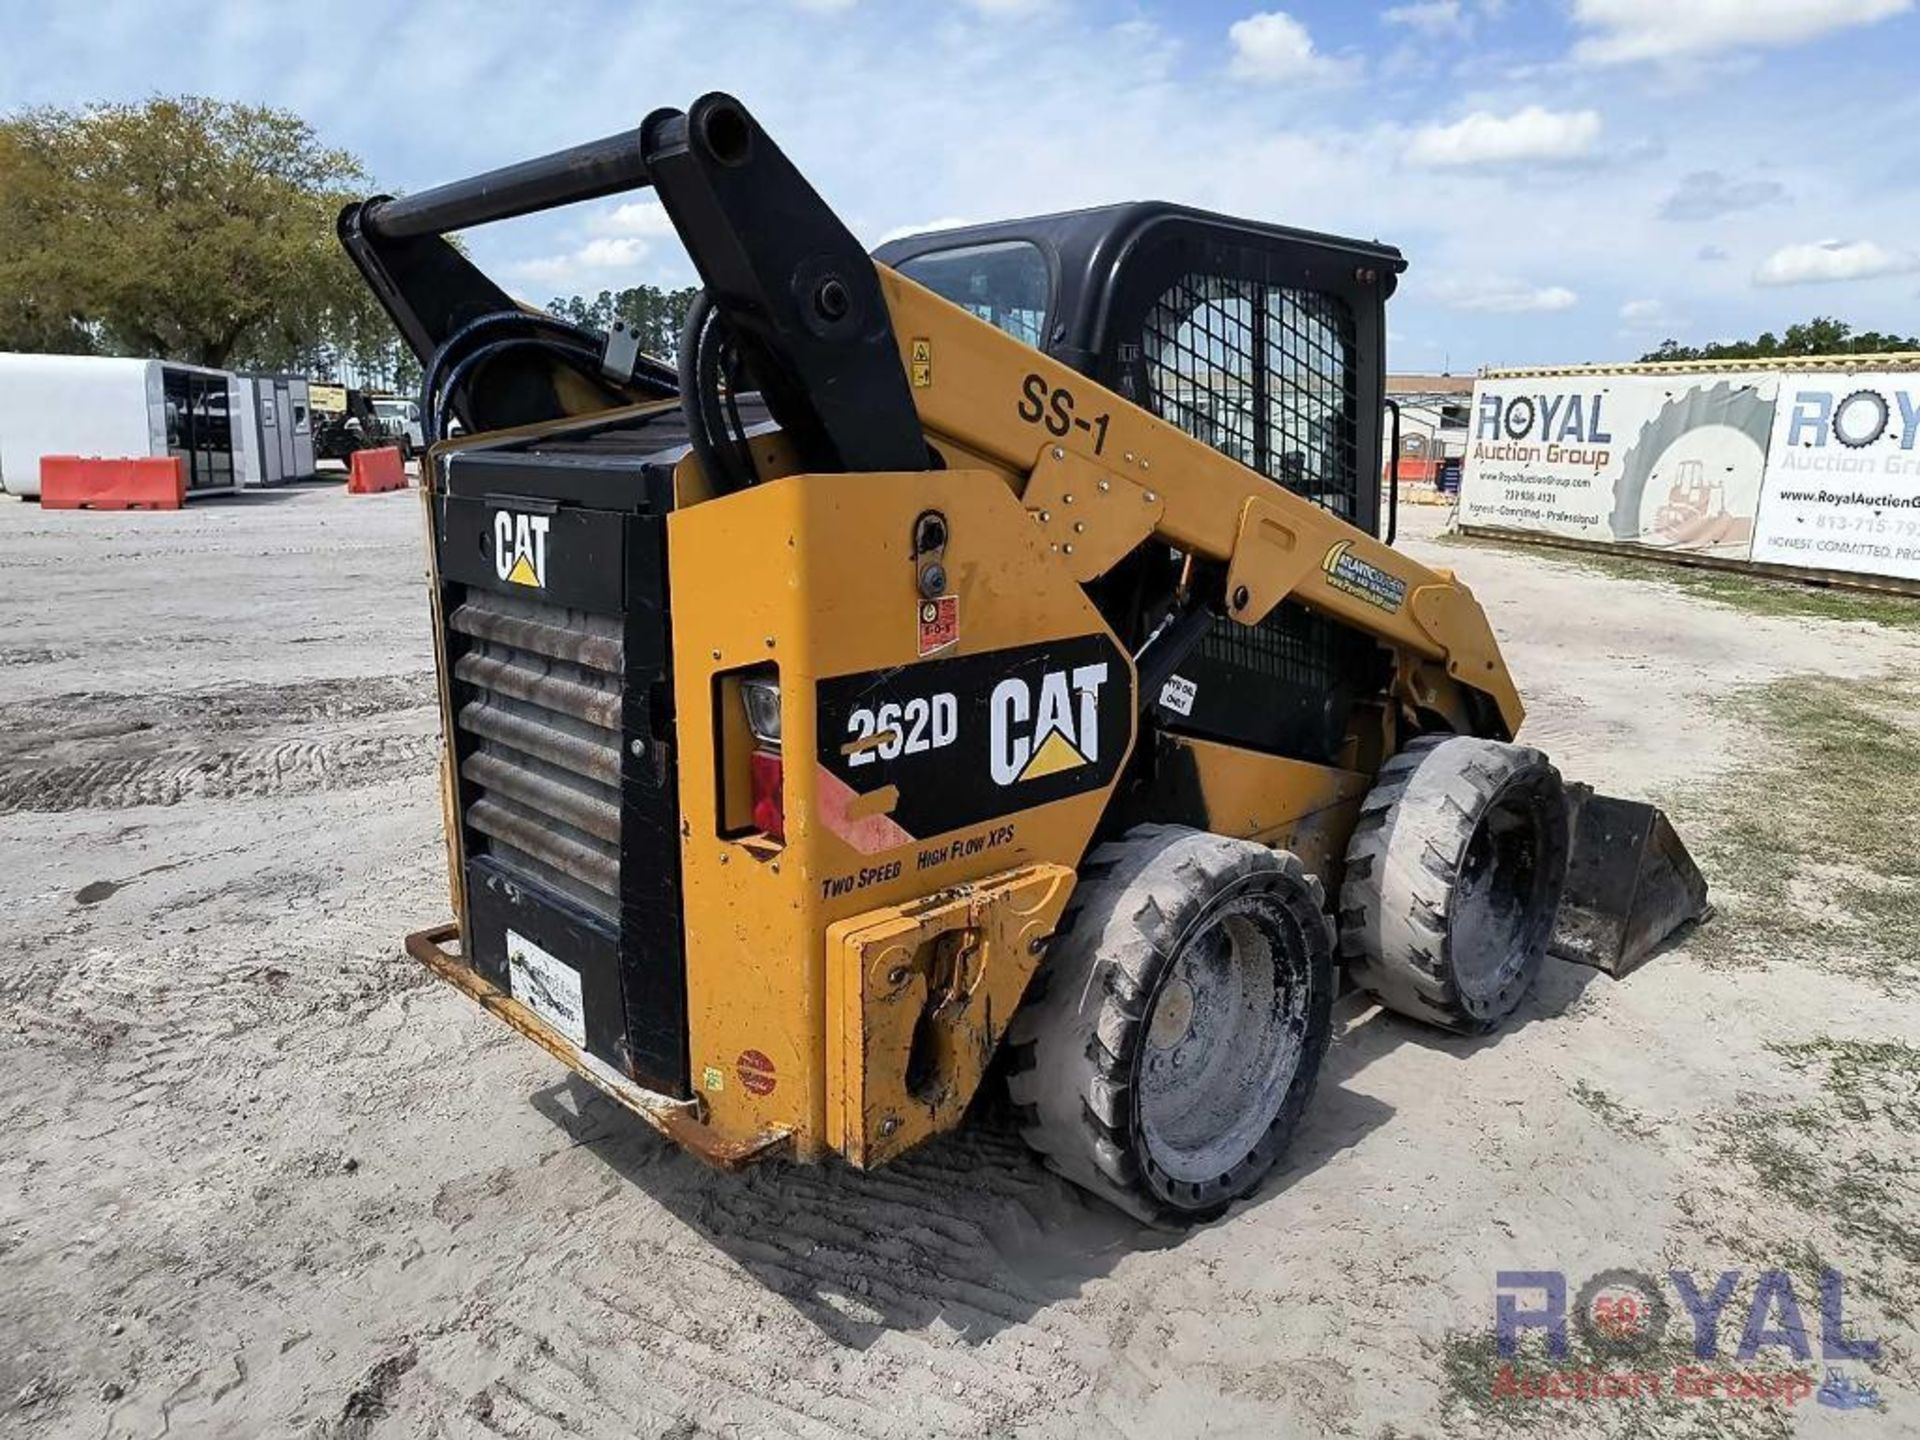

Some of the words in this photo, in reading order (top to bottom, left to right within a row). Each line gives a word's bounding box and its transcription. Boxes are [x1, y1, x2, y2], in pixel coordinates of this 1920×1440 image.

[1018, 373, 1110, 456] SS-1
[1475, 393, 1612, 443] ROYAL
[1474, 441, 1541, 462] Auction
[1546, 443, 1611, 470] Group
[1781, 451, 1875, 472] Auction
[494, 510, 550, 588] CAT
[847, 692, 958, 767] 262D
[990, 662, 1108, 786] CAT
[987, 824, 1015, 848] XPS
